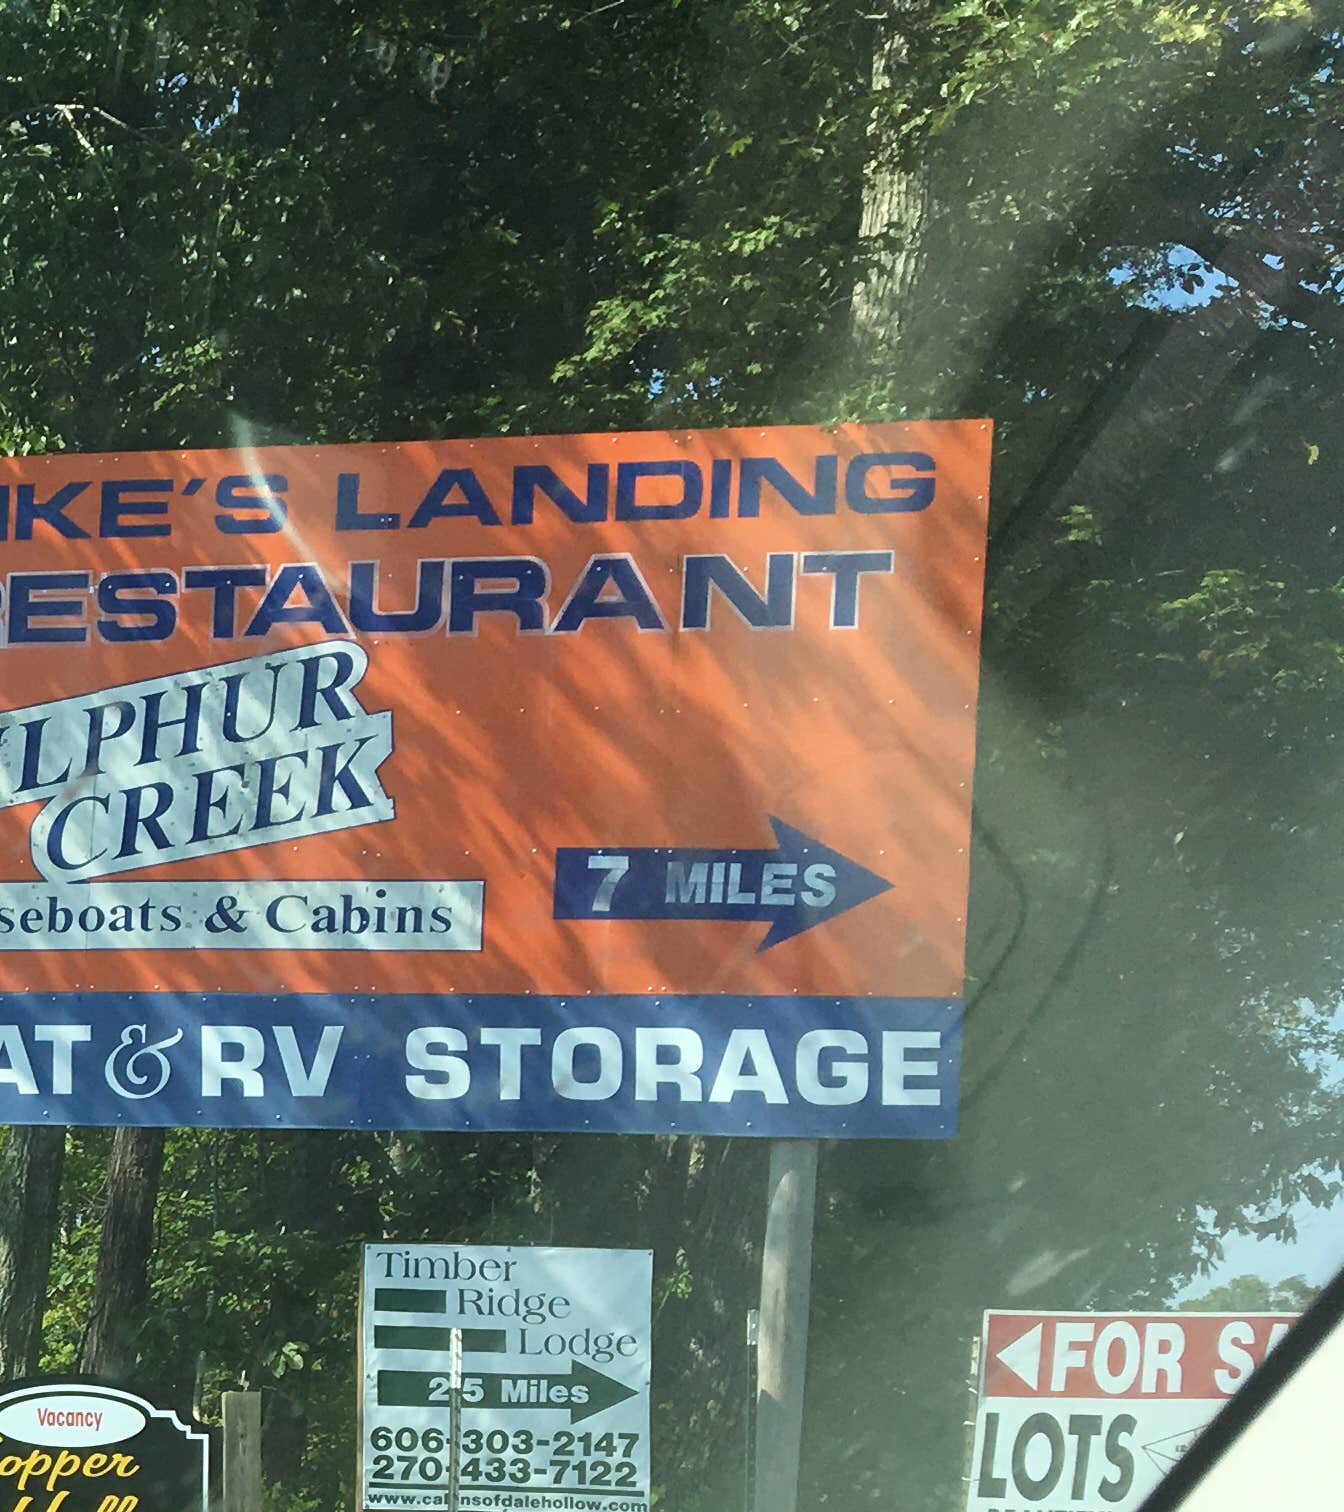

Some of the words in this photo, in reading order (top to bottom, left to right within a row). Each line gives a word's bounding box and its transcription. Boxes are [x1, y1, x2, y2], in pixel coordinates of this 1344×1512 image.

[335, 450, 938, 533] LANDING
[46, 735, 378, 871] CREEK
[588, 855, 630, 912] 7
[665, 862, 836, 907] MILES
[205, 895, 247, 933] &
[265, 889, 454, 937] Cabins
[106, 1025, 182, 1100] &
[200, 1026, 345, 1100] RV
[405, 1027, 943, 1107] STORAGE
[376, 1251, 517, 1282] Timber
[457, 1288, 572, 1325] Ridge
[519, 1328, 638, 1363] Lodge
[1050, 1320, 1186, 1394] FOR
[1214, 1321, 1289, 1394] S
[501, 1378, 590, 1404] Miles
[37, 1407, 103, 1431] Vacancy
[370, 1426, 640, 1459] 606303-2147
[977, 1411, 1139, 1503] LOTS
[372, 1455, 638, 1488] 270433-7122
[367, 1493, 649, 1512] www.cansofdalehollow.com
